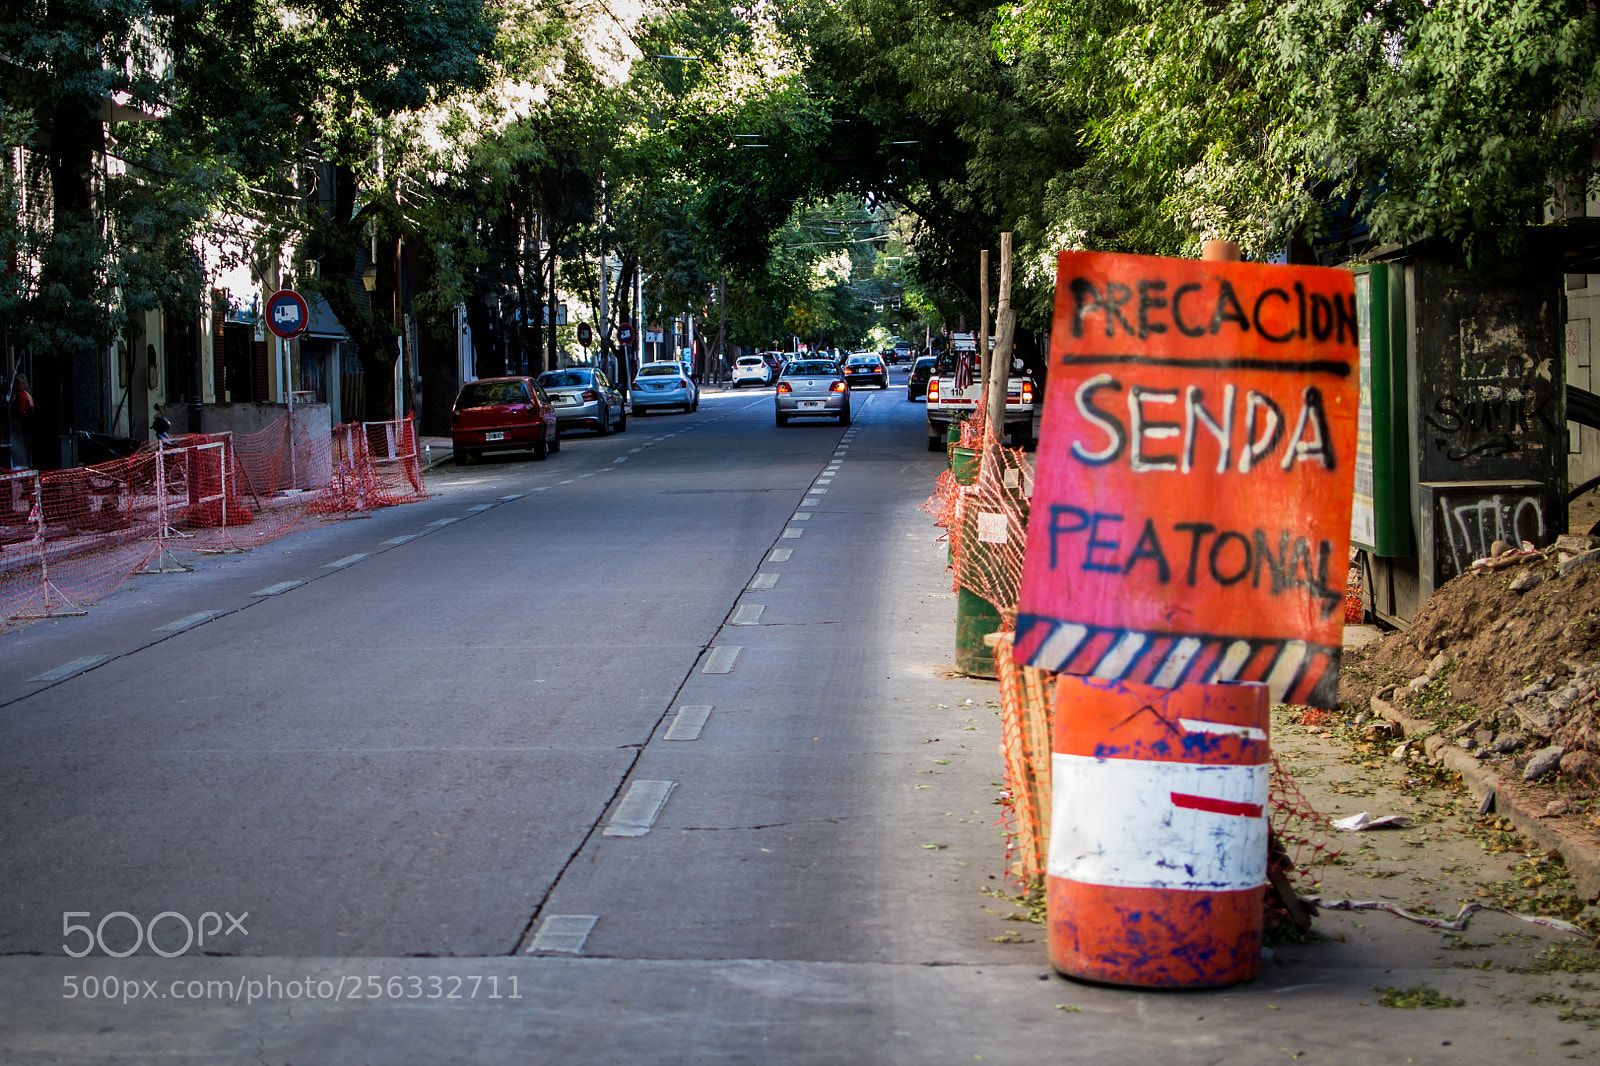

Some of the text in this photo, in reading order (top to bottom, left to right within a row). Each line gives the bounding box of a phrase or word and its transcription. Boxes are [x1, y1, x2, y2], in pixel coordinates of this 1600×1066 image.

[1070, 277, 1357, 347] PRECACION
[951, 388, 964, 396] 110
[1071, 373, 1336, 474] SENDA
[1048, 504, 1344, 618] PEATONAL
